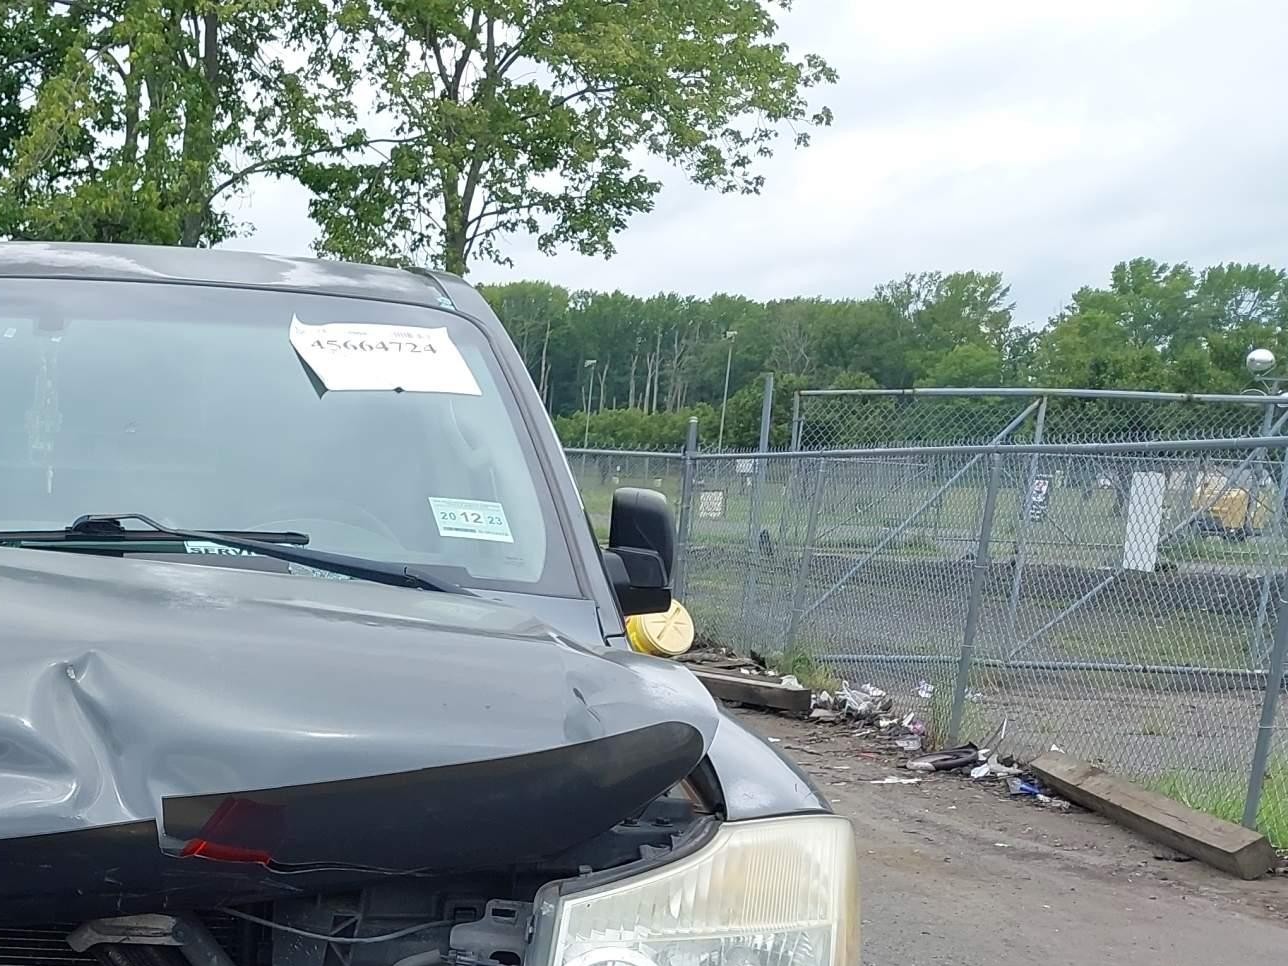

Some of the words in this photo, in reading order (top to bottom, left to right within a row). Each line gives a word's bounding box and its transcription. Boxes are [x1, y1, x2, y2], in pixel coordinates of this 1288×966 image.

[310, 339, 438, 355] 45664724
[439, 511, 457, 521] 20
[460, 511, 484, 524] 12
[487, 515, 503, 526] 23
